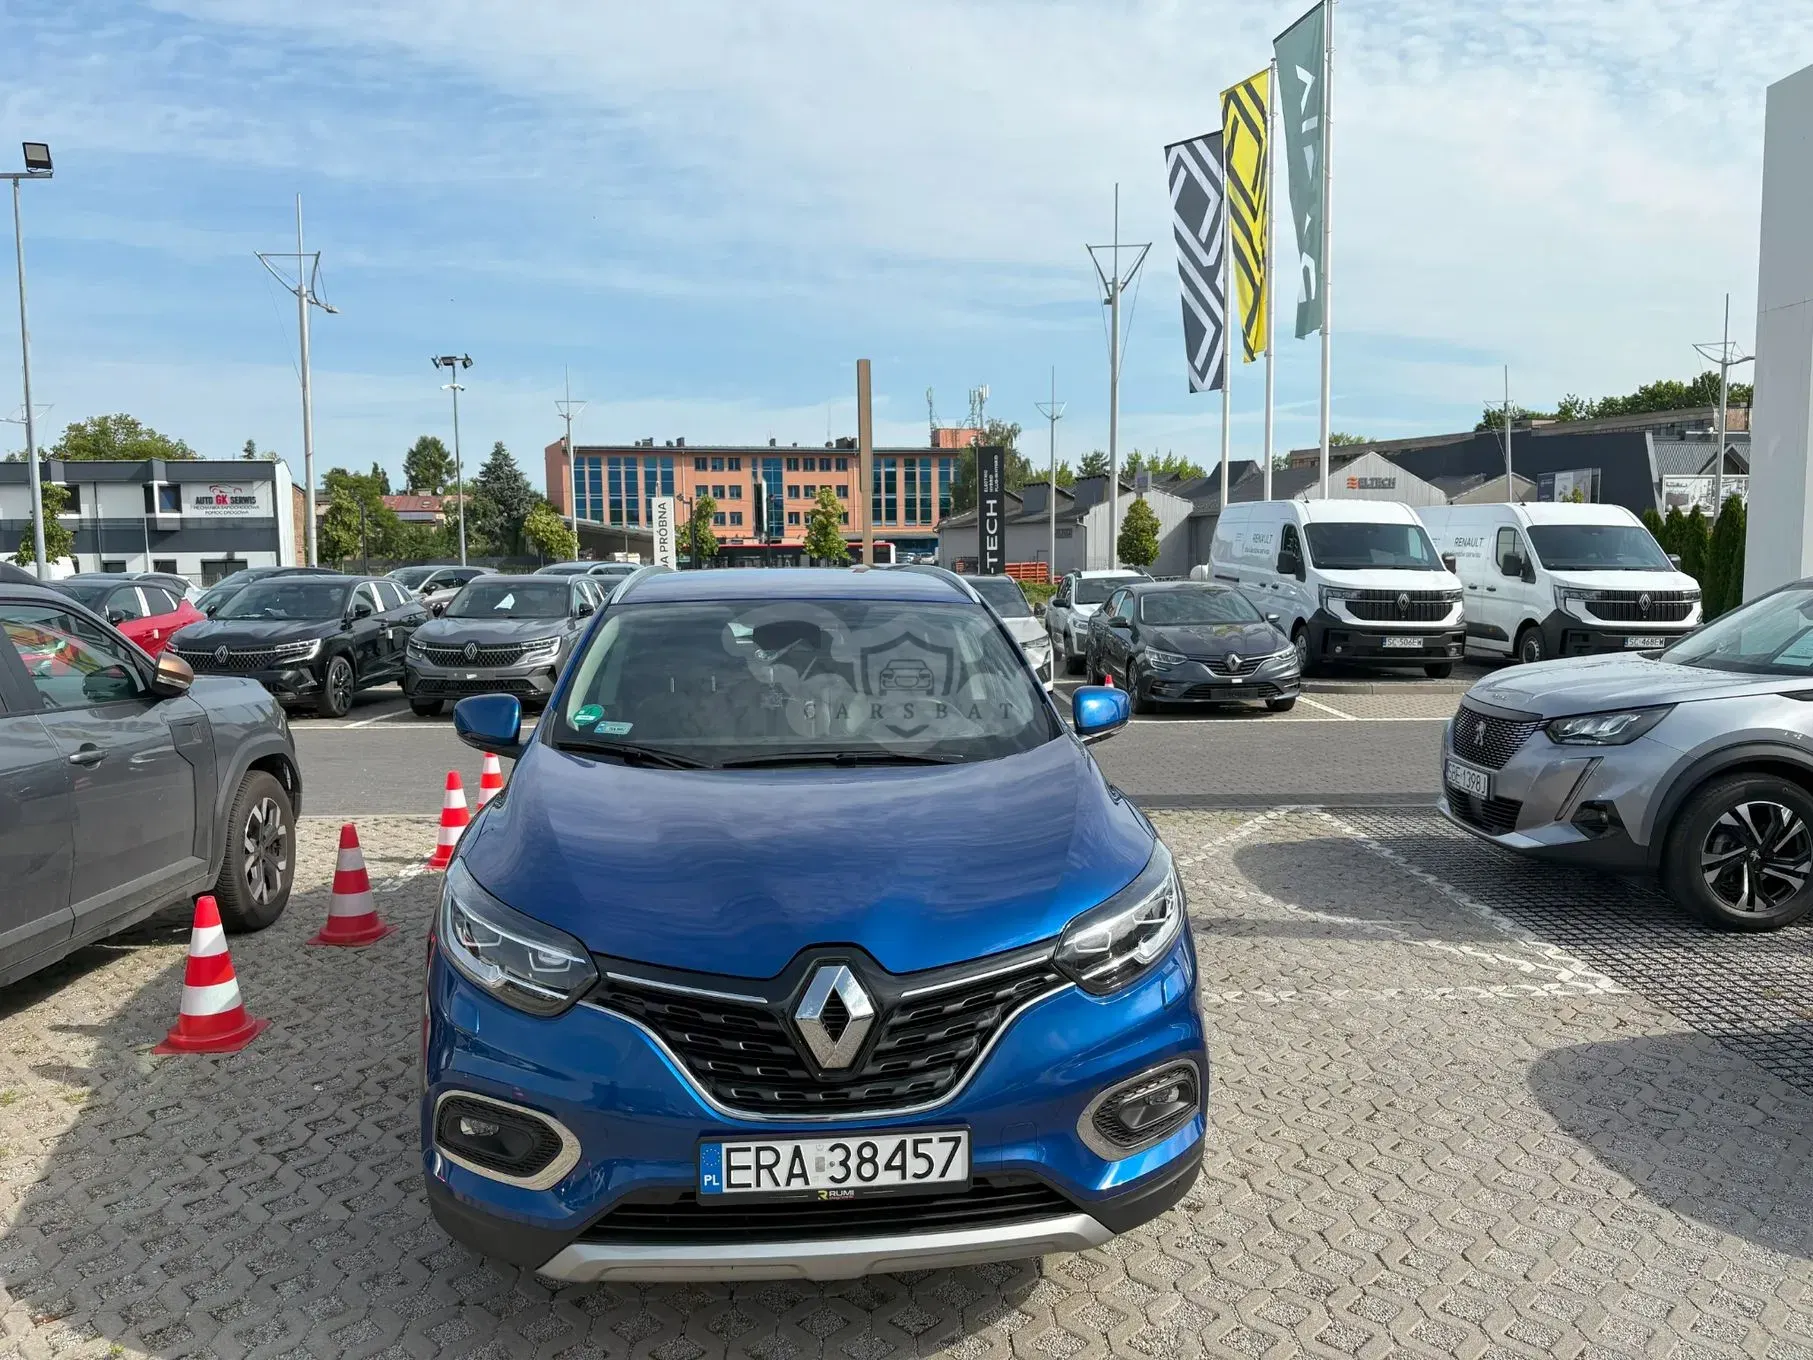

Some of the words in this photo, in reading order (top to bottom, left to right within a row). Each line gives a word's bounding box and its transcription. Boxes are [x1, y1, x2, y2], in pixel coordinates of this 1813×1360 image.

[195, 496, 213, 505] AUTO
[215, 494, 228, 505] GK
[230, 496, 256, 505] SERWIS
[656, 502, 669, 553] PRÓBNA
[1454, 537, 1485, 547] RENAULT
[1463, 769, 1487, 795] 1398J
[726, 1145, 810, 1188] ERA
[828, 1136, 962, 1184] 38457
[704, 1174, 720, 1186] PL
